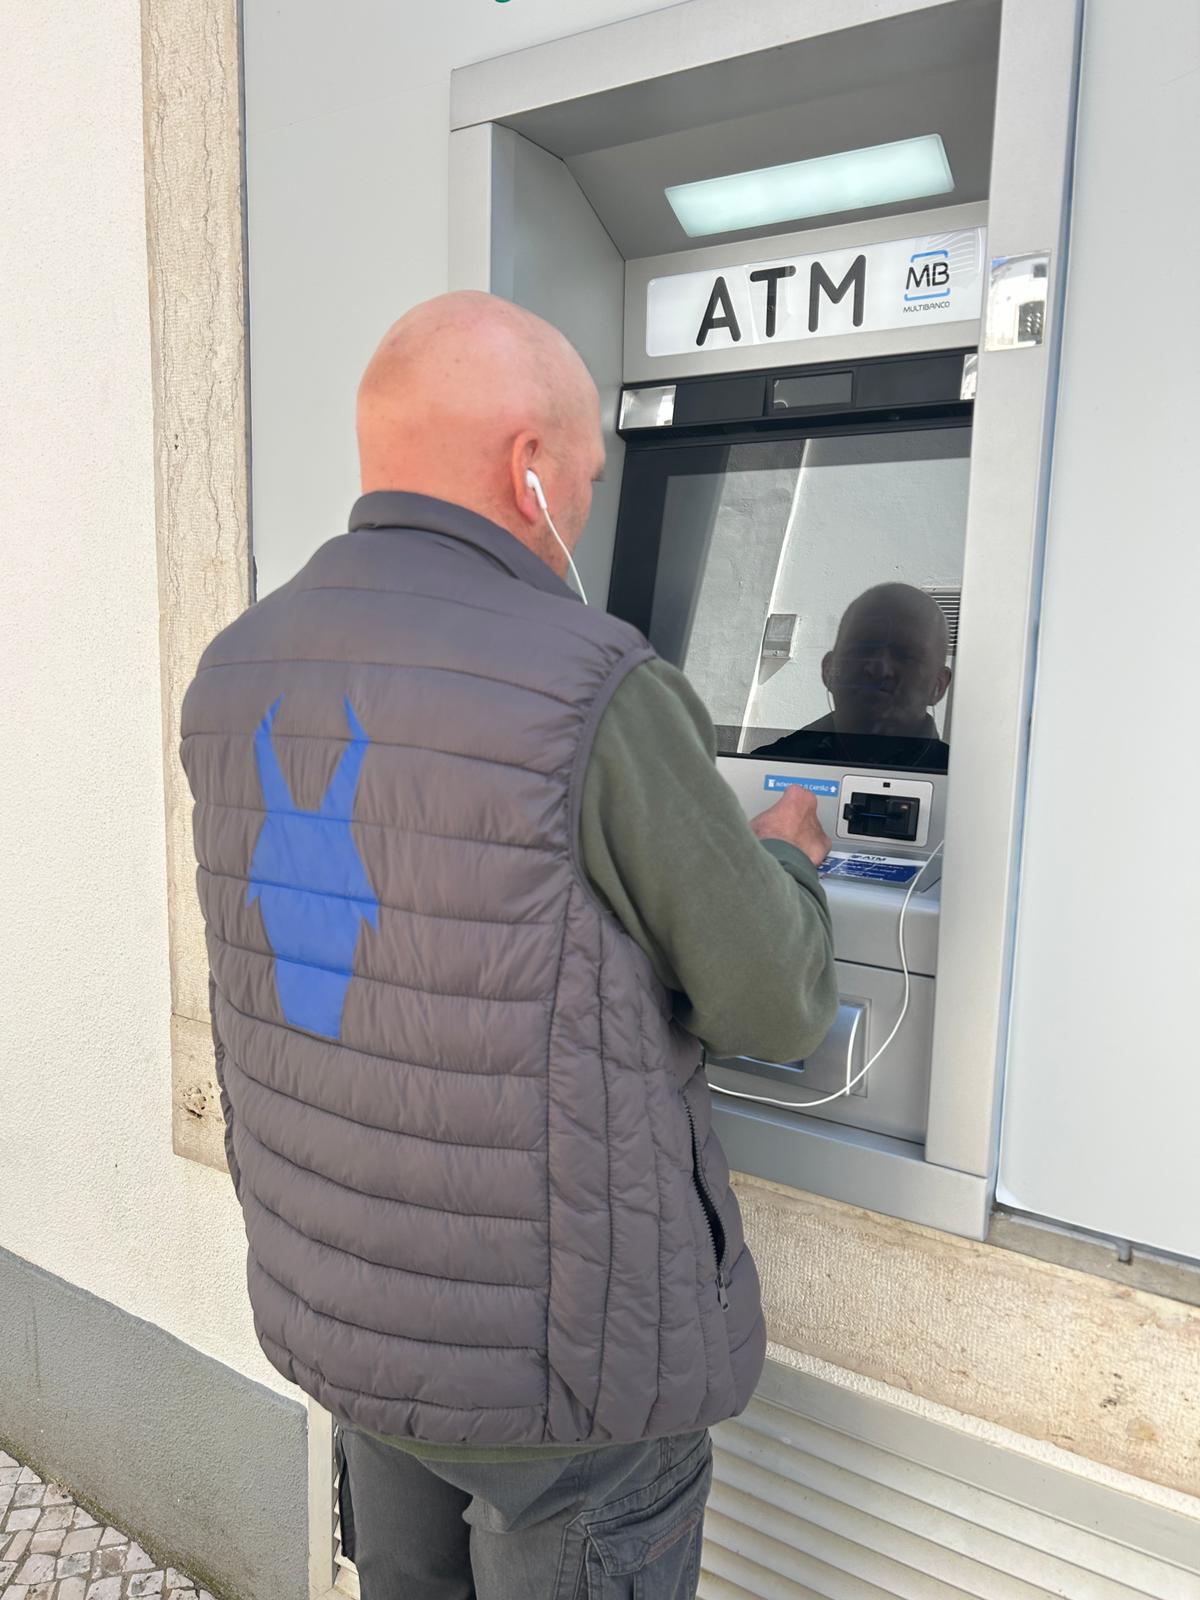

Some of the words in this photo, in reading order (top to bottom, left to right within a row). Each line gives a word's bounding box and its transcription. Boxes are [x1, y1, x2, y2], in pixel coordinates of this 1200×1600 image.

[906, 261, 950, 290] MB
[696, 254, 866, 346] ATM
[903, 301, 950, 312] MULTIBANCO
